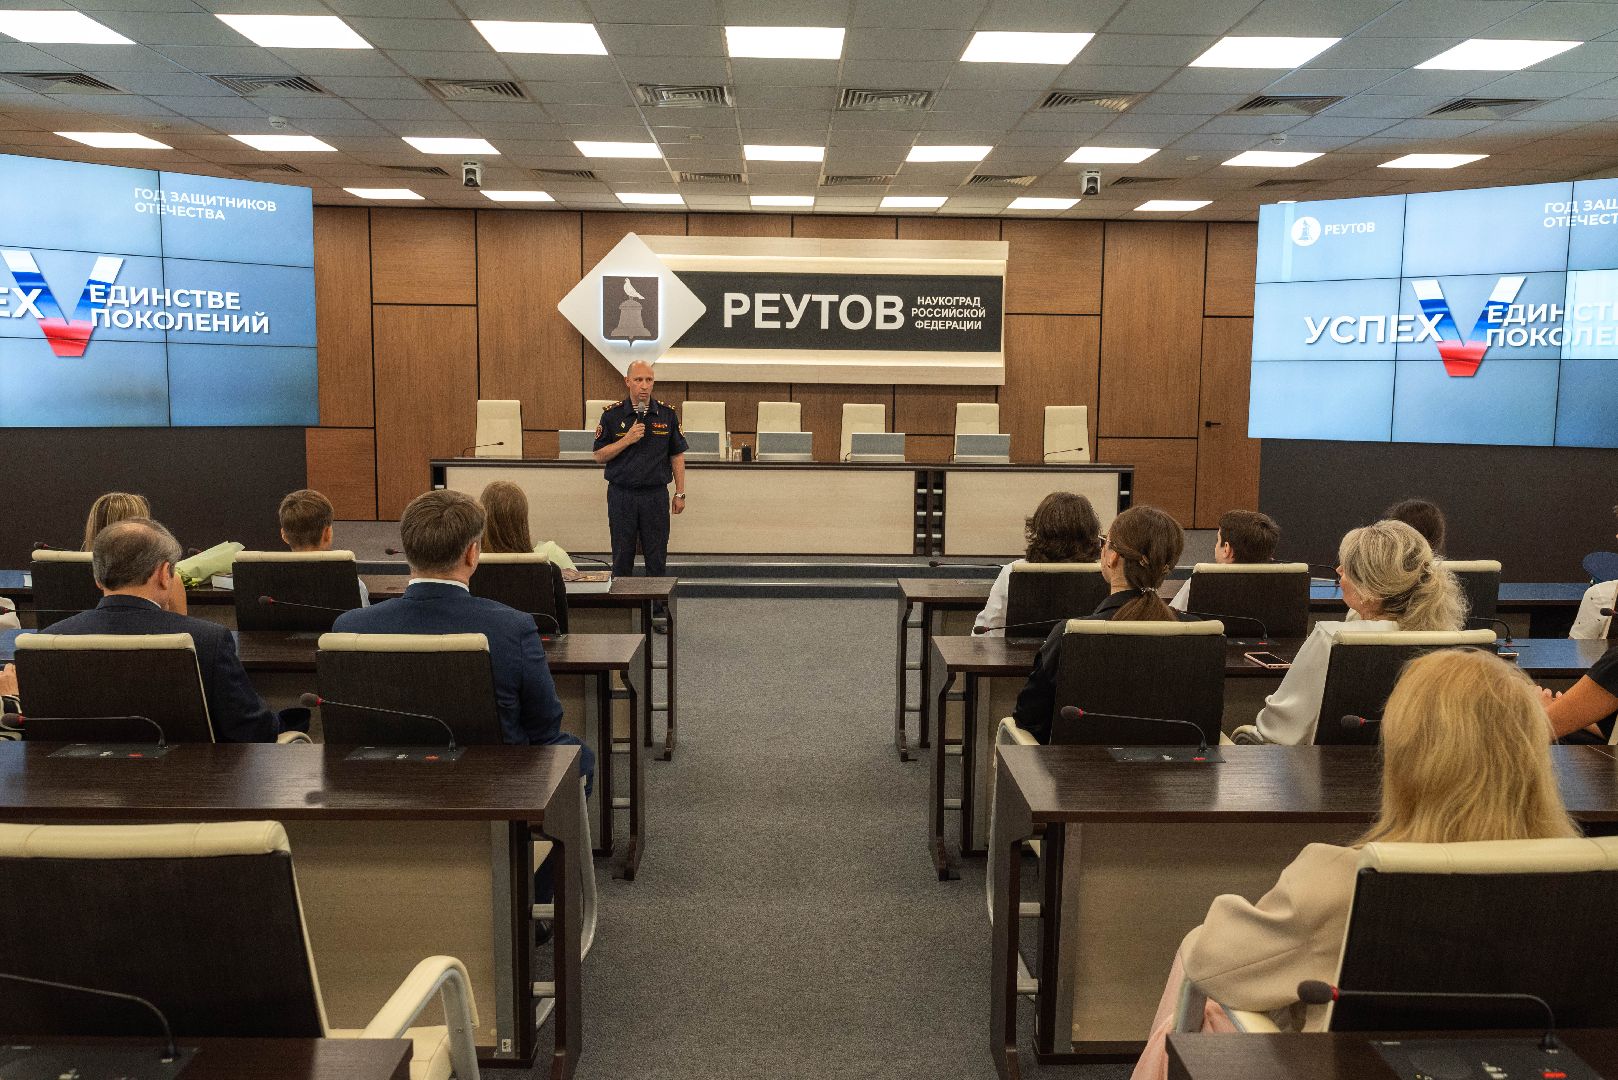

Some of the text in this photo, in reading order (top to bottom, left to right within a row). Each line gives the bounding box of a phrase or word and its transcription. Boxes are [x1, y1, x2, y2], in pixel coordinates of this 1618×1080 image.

[134, 187, 277, 212] ГОД ЗАЩИТНИКОВ
[1544, 200, 1579, 215] ГОД
[134, 202, 226, 221] ОТЕЧЕСТВА
[1324, 221, 1376, 236] РЕУТОВ
[89, 284, 241, 311] ЕДИНСТВЕ
[917, 296, 981, 308] НАУКОГРАД
[90, 307, 270, 334] ПОКОЛЕНИЙ
[723, 292, 905, 331] РЕУТОВ
[911, 306, 986, 318] РОССИЙСКОЙ
[914, 320, 982, 332] ФЕДЕРАЦИИ
[1303, 313, 1446, 344] УСПЕХ
[1487, 302, 1618, 327] ЕДИНСТ
[1486, 326, 1618, 347] ПОКОЛЕ
